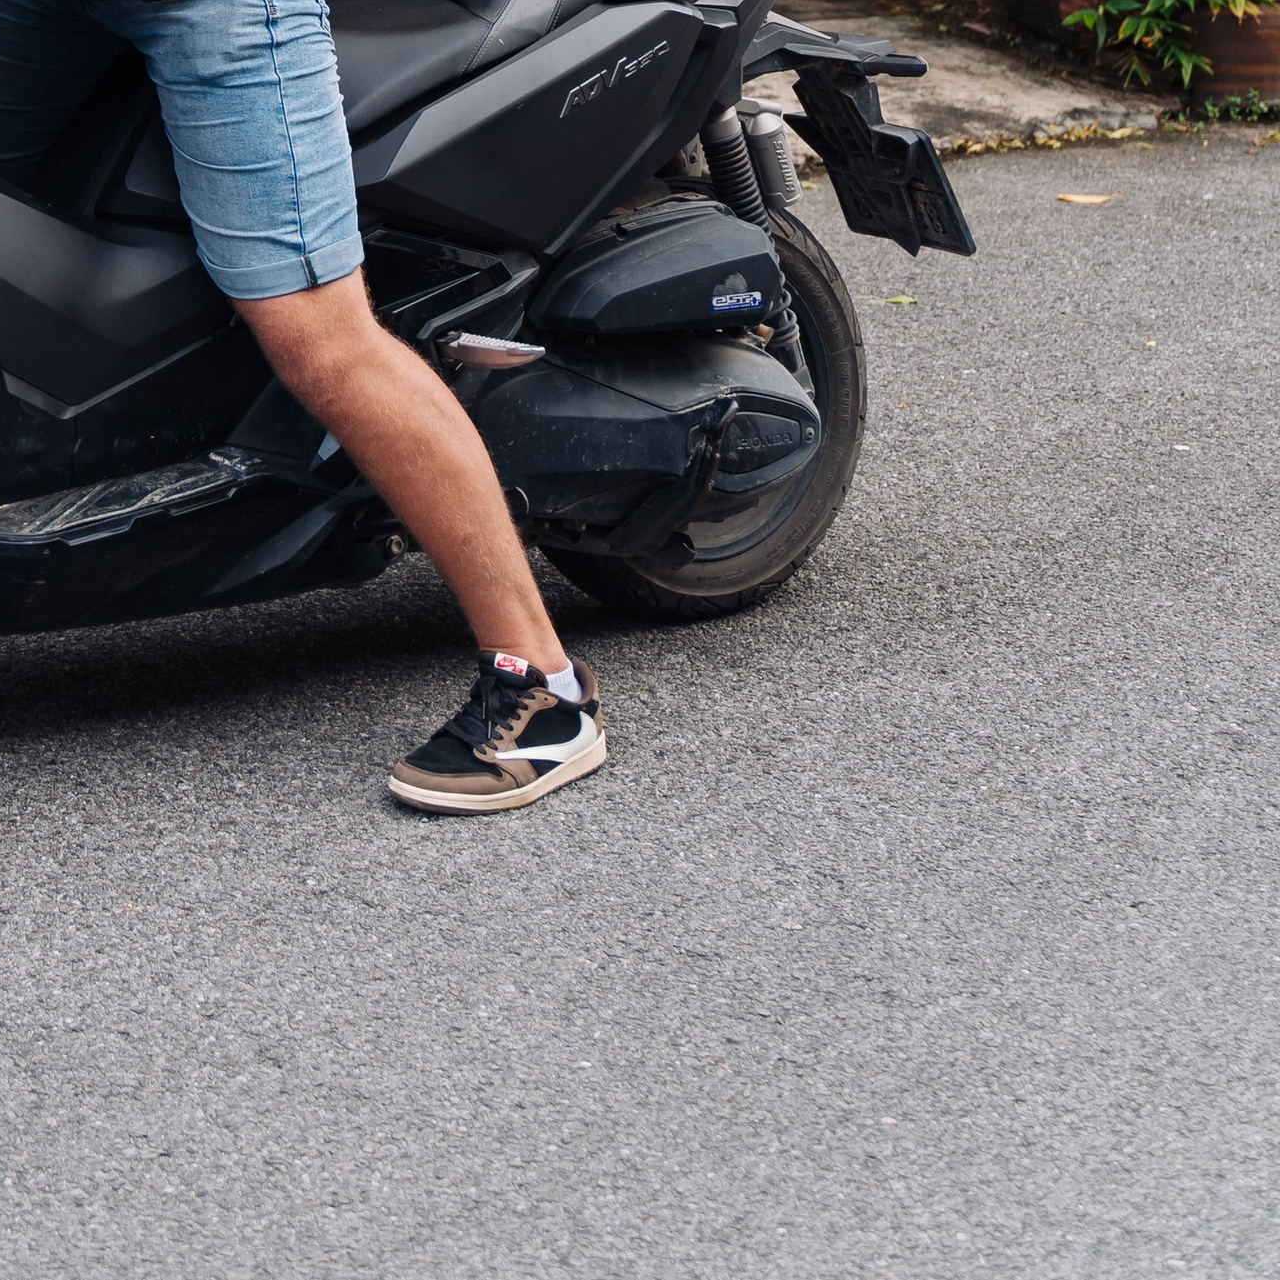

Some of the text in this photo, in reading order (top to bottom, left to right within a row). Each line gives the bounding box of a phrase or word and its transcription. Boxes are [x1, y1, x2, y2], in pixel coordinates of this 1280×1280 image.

[737, 432, 794, 450] HONDA
[501, 656, 518, 666] NIKE
[511, 666, 525, 675] AIR
